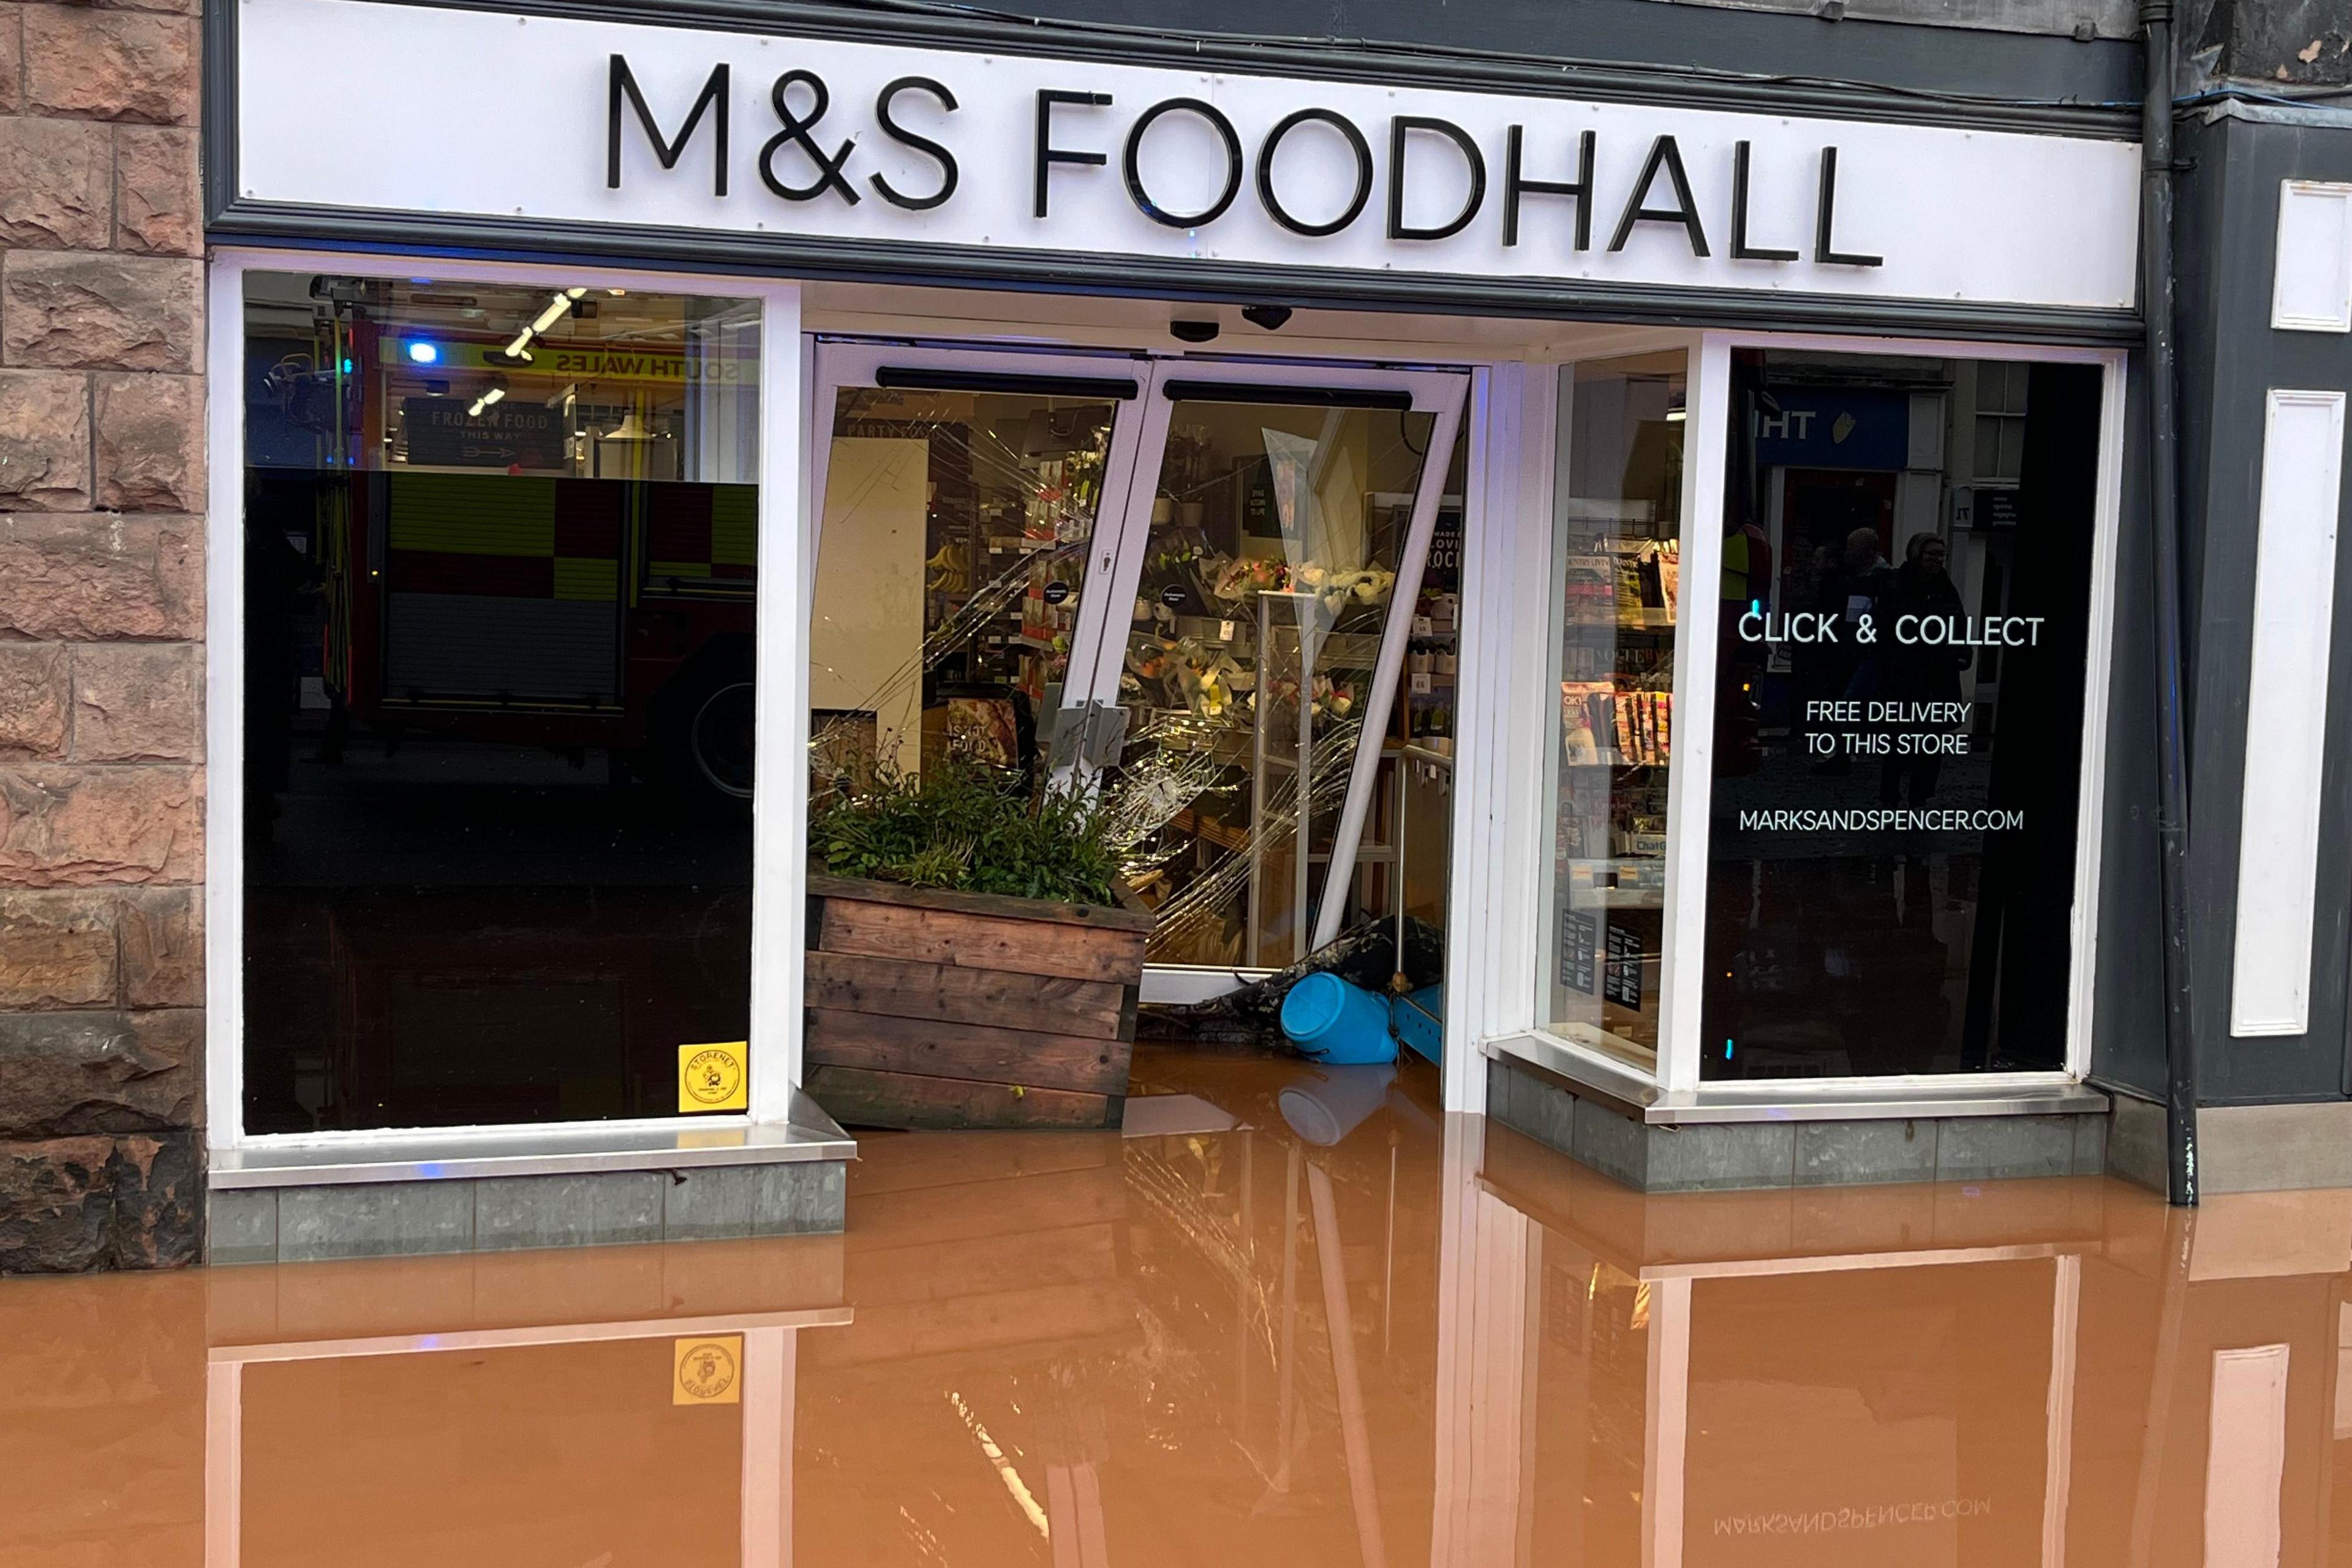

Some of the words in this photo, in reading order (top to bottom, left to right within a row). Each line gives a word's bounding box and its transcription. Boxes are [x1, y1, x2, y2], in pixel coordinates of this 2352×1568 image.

[608, 54, 959, 208] M&S
[1035, 89, 1883, 268] FOODHALL
[504, 413, 548, 429] FOOD
[1738, 612, 1839, 643] CLICK
[1856, 614, 1877, 644] &
[1895, 614, 2045, 647] COLLECT
[1807, 701, 1861, 722] FREE
[1868, 701, 1972, 723] DELIVERY
[1804, 733, 1836, 755] TO
[1841, 733, 1890, 755] THIS
[1896, 734, 1968, 755] STORE
[1740, 810, 2024, 831] MARKSANDSPENCER.COM
